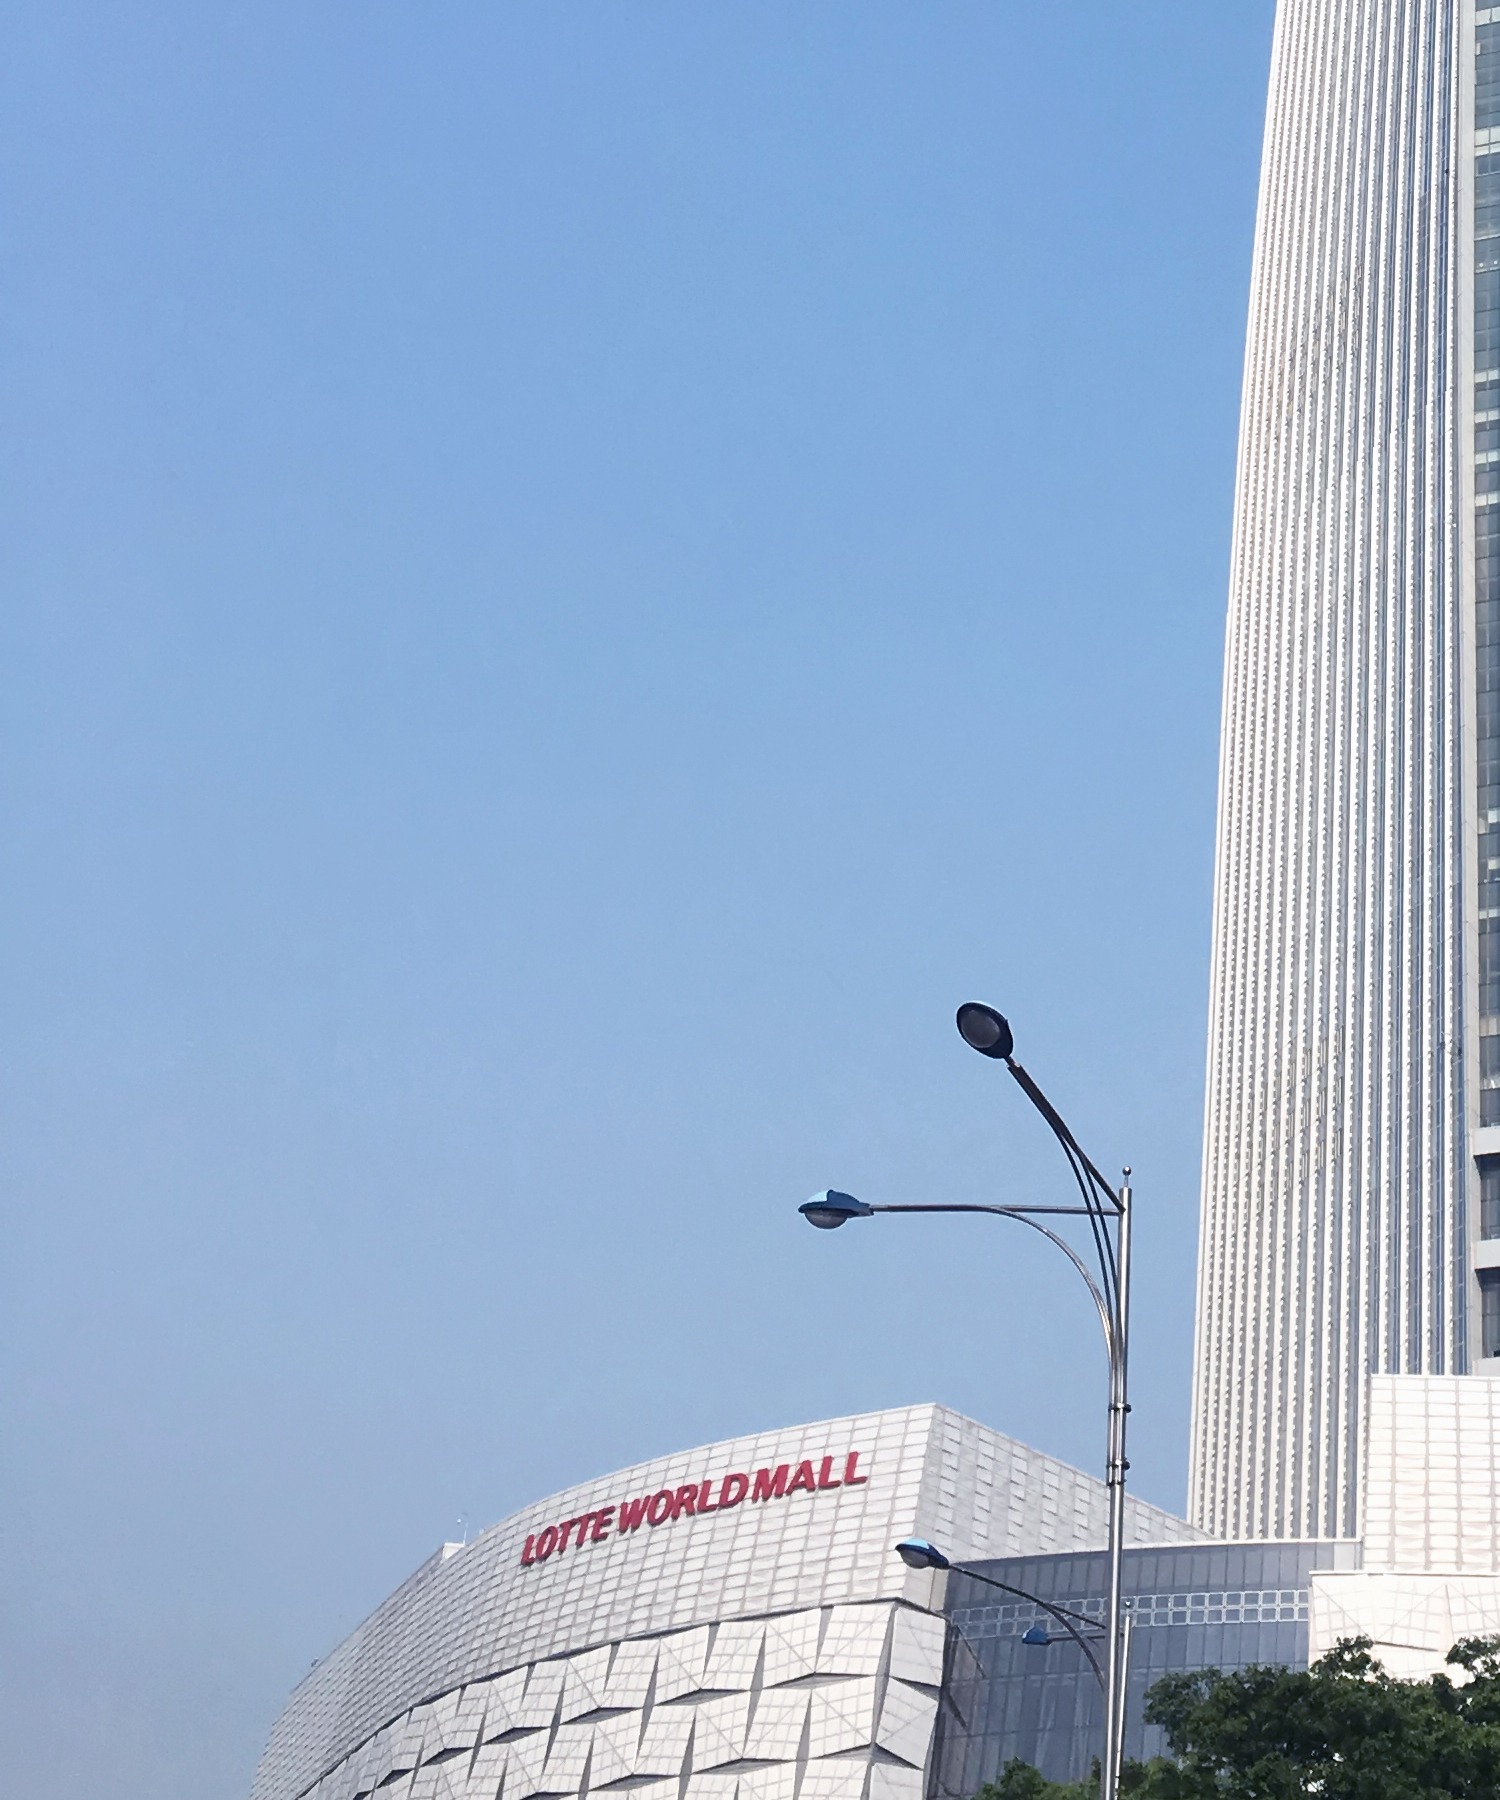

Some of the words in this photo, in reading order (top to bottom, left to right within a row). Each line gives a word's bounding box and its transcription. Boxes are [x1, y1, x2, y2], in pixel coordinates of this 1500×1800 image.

[520, 1505, 616, 1565] LOTTE
[618, 1472, 749, 1533] WORLD
[751, 1451, 868, 1502] MALL
